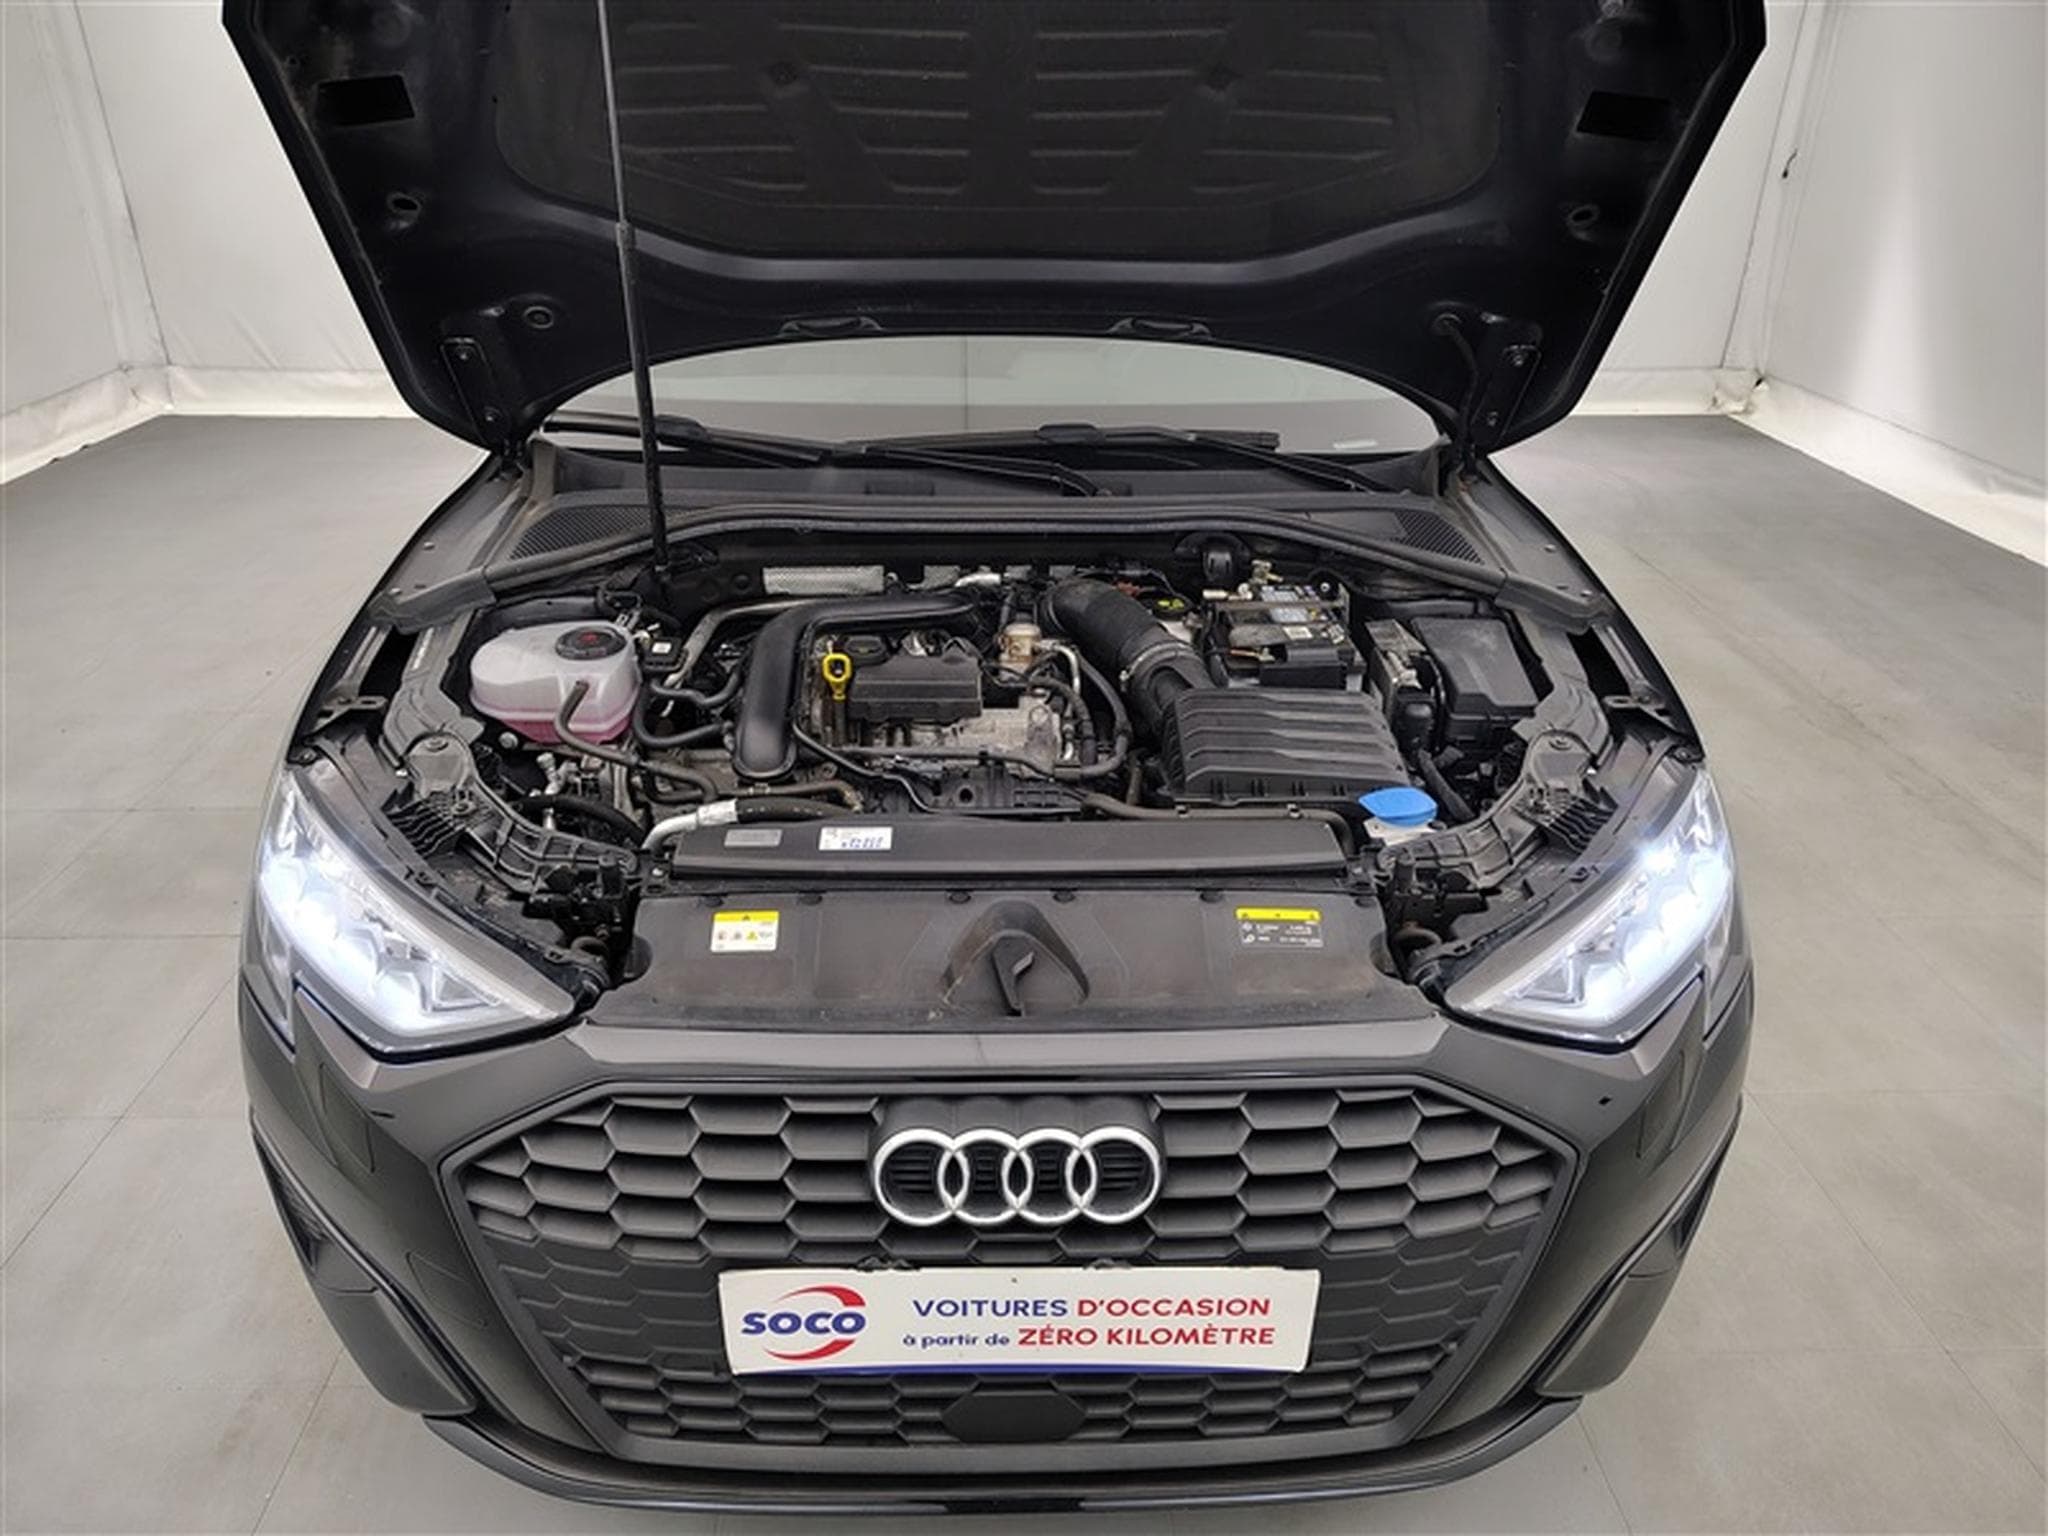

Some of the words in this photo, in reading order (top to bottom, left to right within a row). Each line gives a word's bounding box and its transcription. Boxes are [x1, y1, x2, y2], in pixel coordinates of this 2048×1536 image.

[912, 1299, 1067, 1318] VOITURES
[1077, 1298, 1271, 1317] D'OCCASION
[742, 1312, 867, 1335] SOCO
[902, 1335, 917, 1347] à
[920, 1334, 979, 1350] partir
[983, 1333, 1011, 1346] de
[1019, 1324, 1098, 1345] ZÉRO
[1107, 1323, 1275, 1346] KILOMÈTRE
